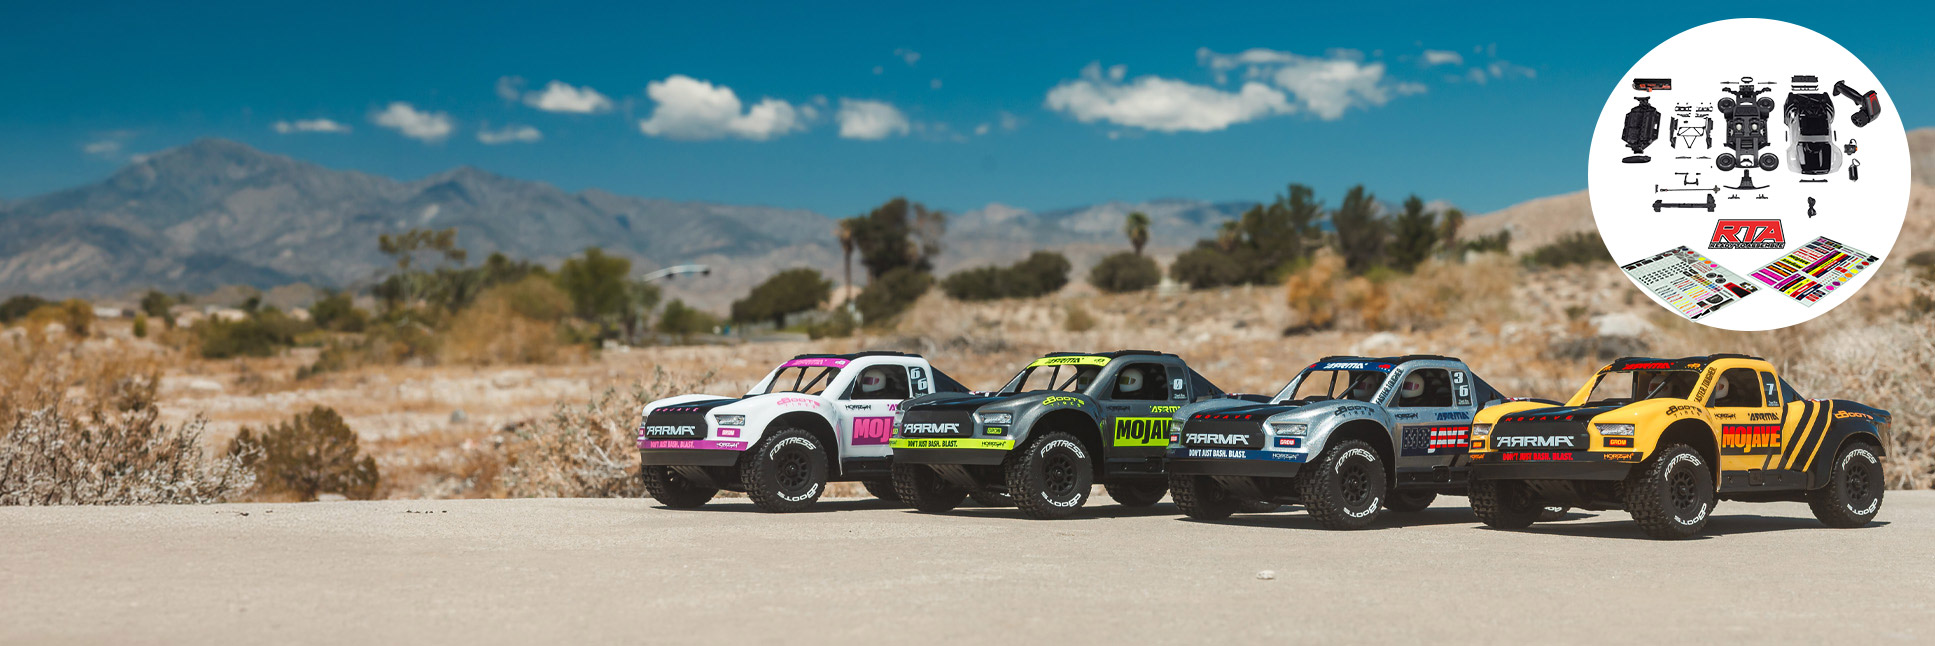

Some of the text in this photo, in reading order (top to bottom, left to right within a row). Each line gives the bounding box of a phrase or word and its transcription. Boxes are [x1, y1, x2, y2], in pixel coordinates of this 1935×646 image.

[911, 368, 920, 379] 6
[918, 379, 927, 391] 6
[1454, 372, 1464, 384] 3
[1459, 384, 1469, 397] 6
[1766, 383, 1775, 396] 7
[854, 418, 894, 443] MOJ
[1116, 419, 1171, 444] MOJAV
[1404, 426, 1469, 454] MOJAVE
[1496, 435, 1574, 448] ARRMA
[1722, 425, 1781, 453] MOJAVE
[770, 436, 816, 460] FORTRESS
[1041, 439, 1085, 458] FORTRESS
[1841, 448, 1877, 471] FORTRESS
[1335, 448, 1376, 474] FORTRESS
[1664, 453, 1702, 481] FORTRESS
